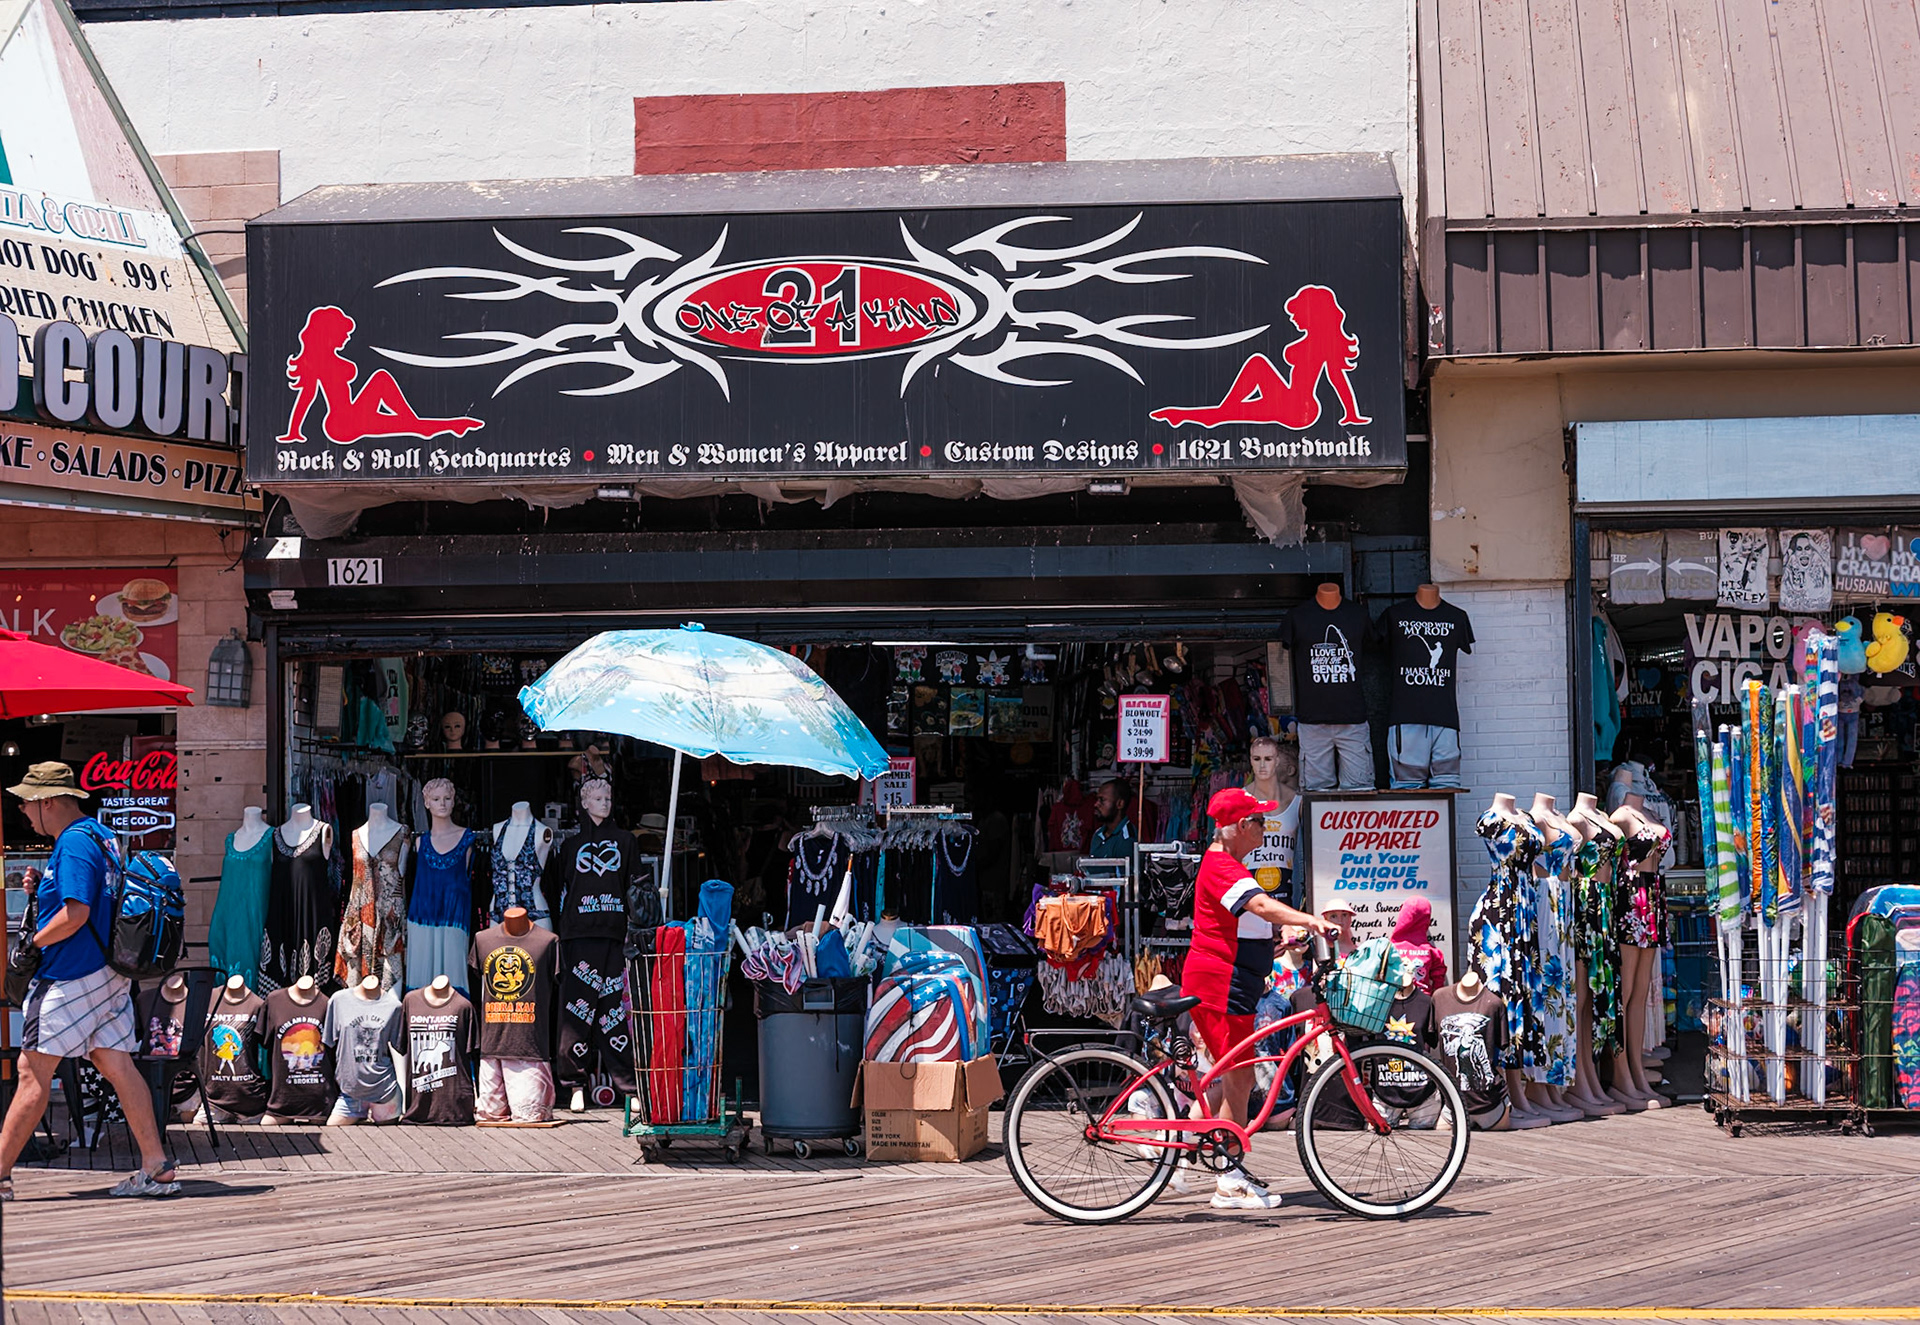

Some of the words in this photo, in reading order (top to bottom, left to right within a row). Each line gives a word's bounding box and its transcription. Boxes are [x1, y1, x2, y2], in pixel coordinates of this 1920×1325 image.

[41, 197, 65, 234] &
[64, 202, 147, 248] GRILL
[41, 245, 97, 281] DOG
[761, 265, 861, 348] 21
[62, 295, 176, 338] CHICKEN
[675, 300, 760, 335] ONE
[765, 299, 821, 334] OF
[825, 303, 857, 331] A
[276, 449, 335, 472] Rock
[342, 450, 364, 472] &
[371, 448, 421, 471] Roll
[428, 446, 571, 474] Headquartes
[606, 443, 660, 465] Men
[667, 443, 690, 466] &
[697, 442, 806, 464] Women's
[814, 440, 908, 468] Apparel
[943, 439, 1035, 463] Custom
[1042, 439, 1139, 467] Designs
[1176, 440, 1234, 461] 1621
[1239, 435, 1372, 460] Boardwalk
[50, 441, 166, 485] SALADS
[1841, 546, 1867, 561] MY
[1892, 550, 1917, 566] MY
[331, 559, 382, 584] 1621
[1836, 560, 1891, 579] CRAZY
[1721, 580, 1744, 590] HIS
[1835, 577, 1889, 594] HUSBAND
[1717, 591, 1766, 604] HARLEY
[1404, 626, 1421, 635] MY
[1424, 627, 1449, 636] ROD
[1410, 620, 1434, 628] GOOD
[1435, 622, 1454, 630] WITH
[1315, 648, 1336, 656] LOVE
[1312, 664, 1349, 673] BENDS
[1405, 667, 1429, 675] MAKE
[1431, 668, 1450, 677] FISH
[1313, 674, 1348, 683] OVER
[1405, 674, 1445, 686] COME
[1630, 691, 1662, 705] CRAZY
[1125, 709, 1160, 718] BLOWOUT
[1132, 719, 1149, 727] SALE
[101, 797, 135, 807] TASTES
[137, 796, 170, 805] GREAT
[890, 792, 902, 805] 15
[112, 817, 128, 826] ICE
[130, 816, 158, 825] COLD
[1320, 810, 1440, 830] CUSTOMIZED
[1338, 831, 1421, 851] APPAREL
[1250, 849, 1285, 862] Extra
[1340, 853, 1373, 864] Put
[1378, 852, 1420, 864] Your
[1341, 866, 1419, 878] UNIQUE
[1334, 878, 1398, 892] Design
[1402, 877, 1428, 890] On
[577, 904, 600, 913] WALKS
[485, 1001, 514, 1012] COBRA
[515, 1001, 535, 1012] KAI
[433, 1015, 459, 1023] JUDGE
[410, 1031, 456, 1042] PITBULL
[1389, 1062, 1403, 1071] NOT
[1378, 1071, 1428, 1082] ARGUING
